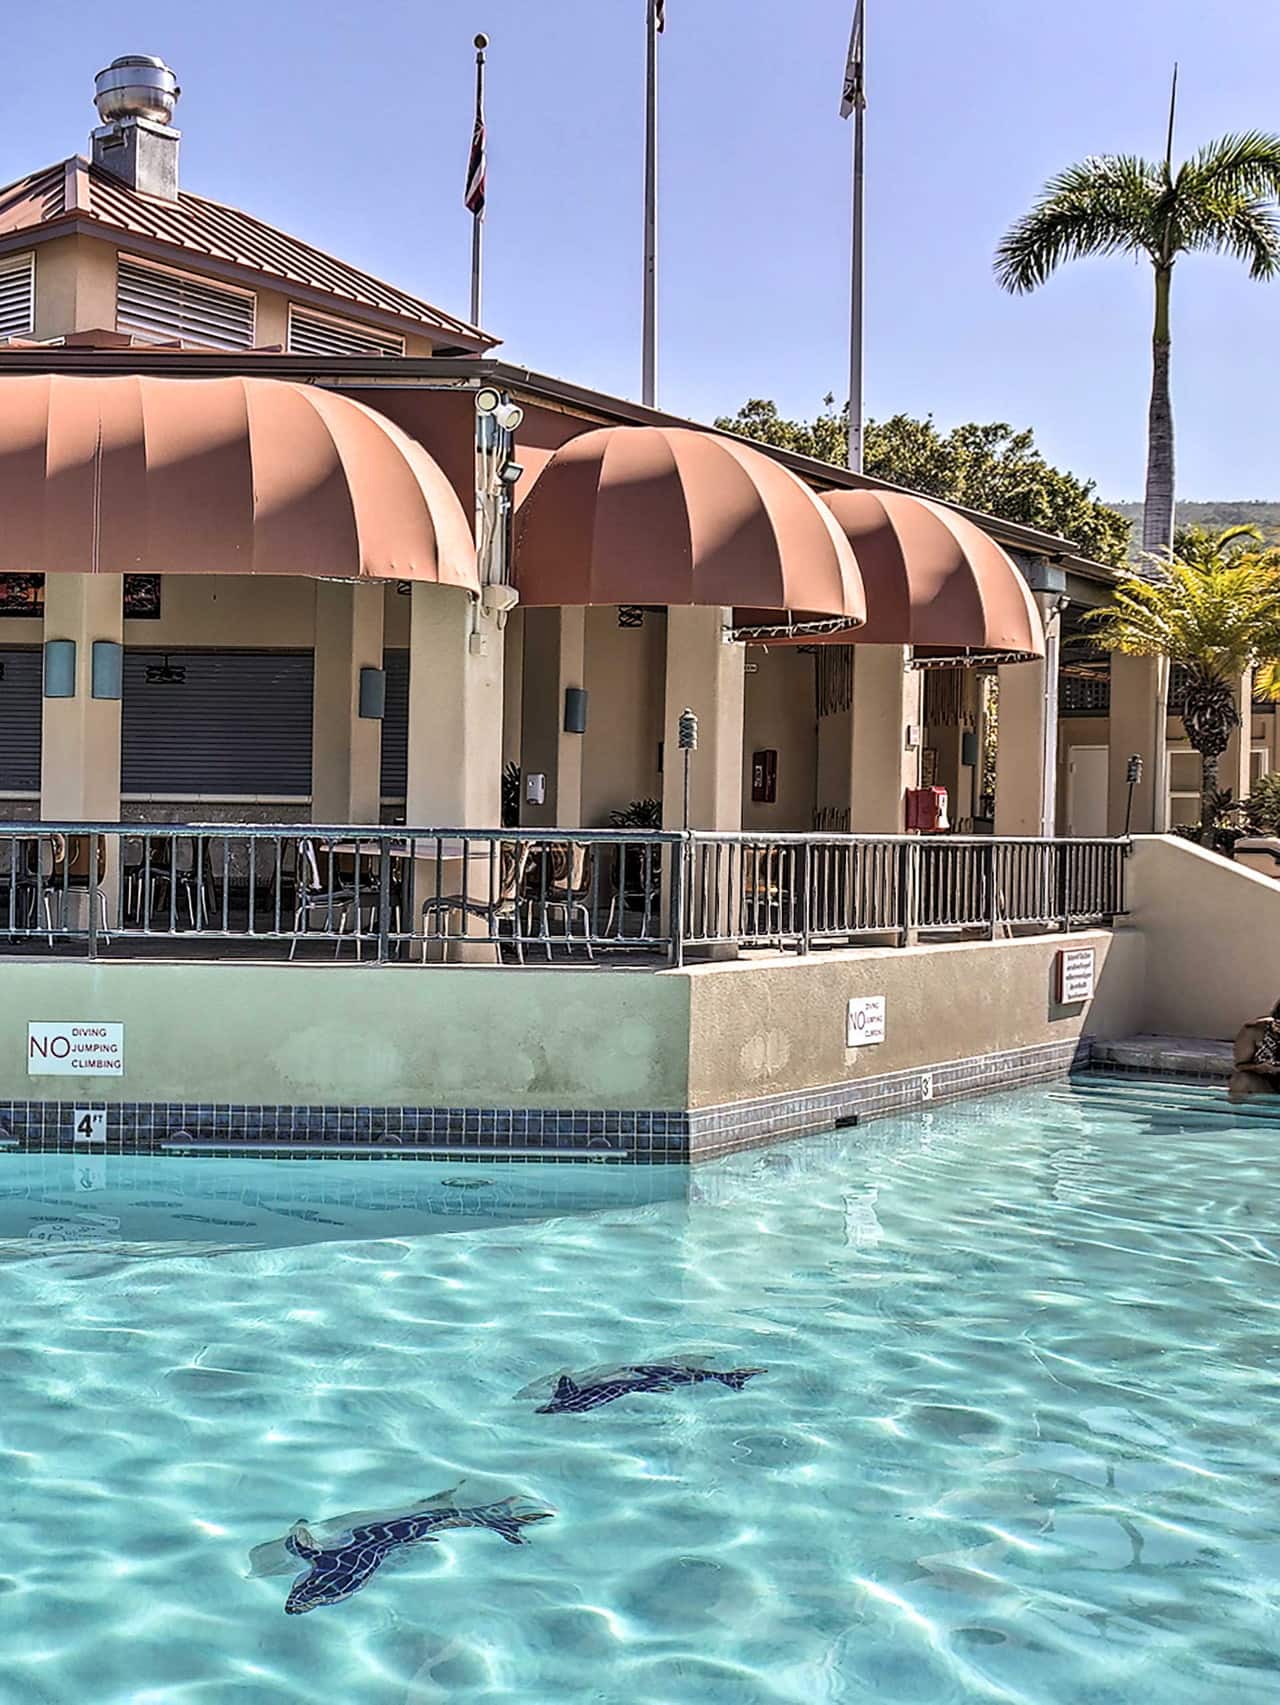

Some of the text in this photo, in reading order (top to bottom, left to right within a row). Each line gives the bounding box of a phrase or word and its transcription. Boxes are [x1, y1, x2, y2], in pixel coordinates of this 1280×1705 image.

[849, 1011, 865, 1031] NO
[71, 1028, 107, 1037] DIVING
[30, 1036, 71, 1058] NO
[71, 1044, 118, 1053] JUMPING
[71, 1059, 121, 1068] CLIMBING
[77, 1114, 93, 1138] 4
